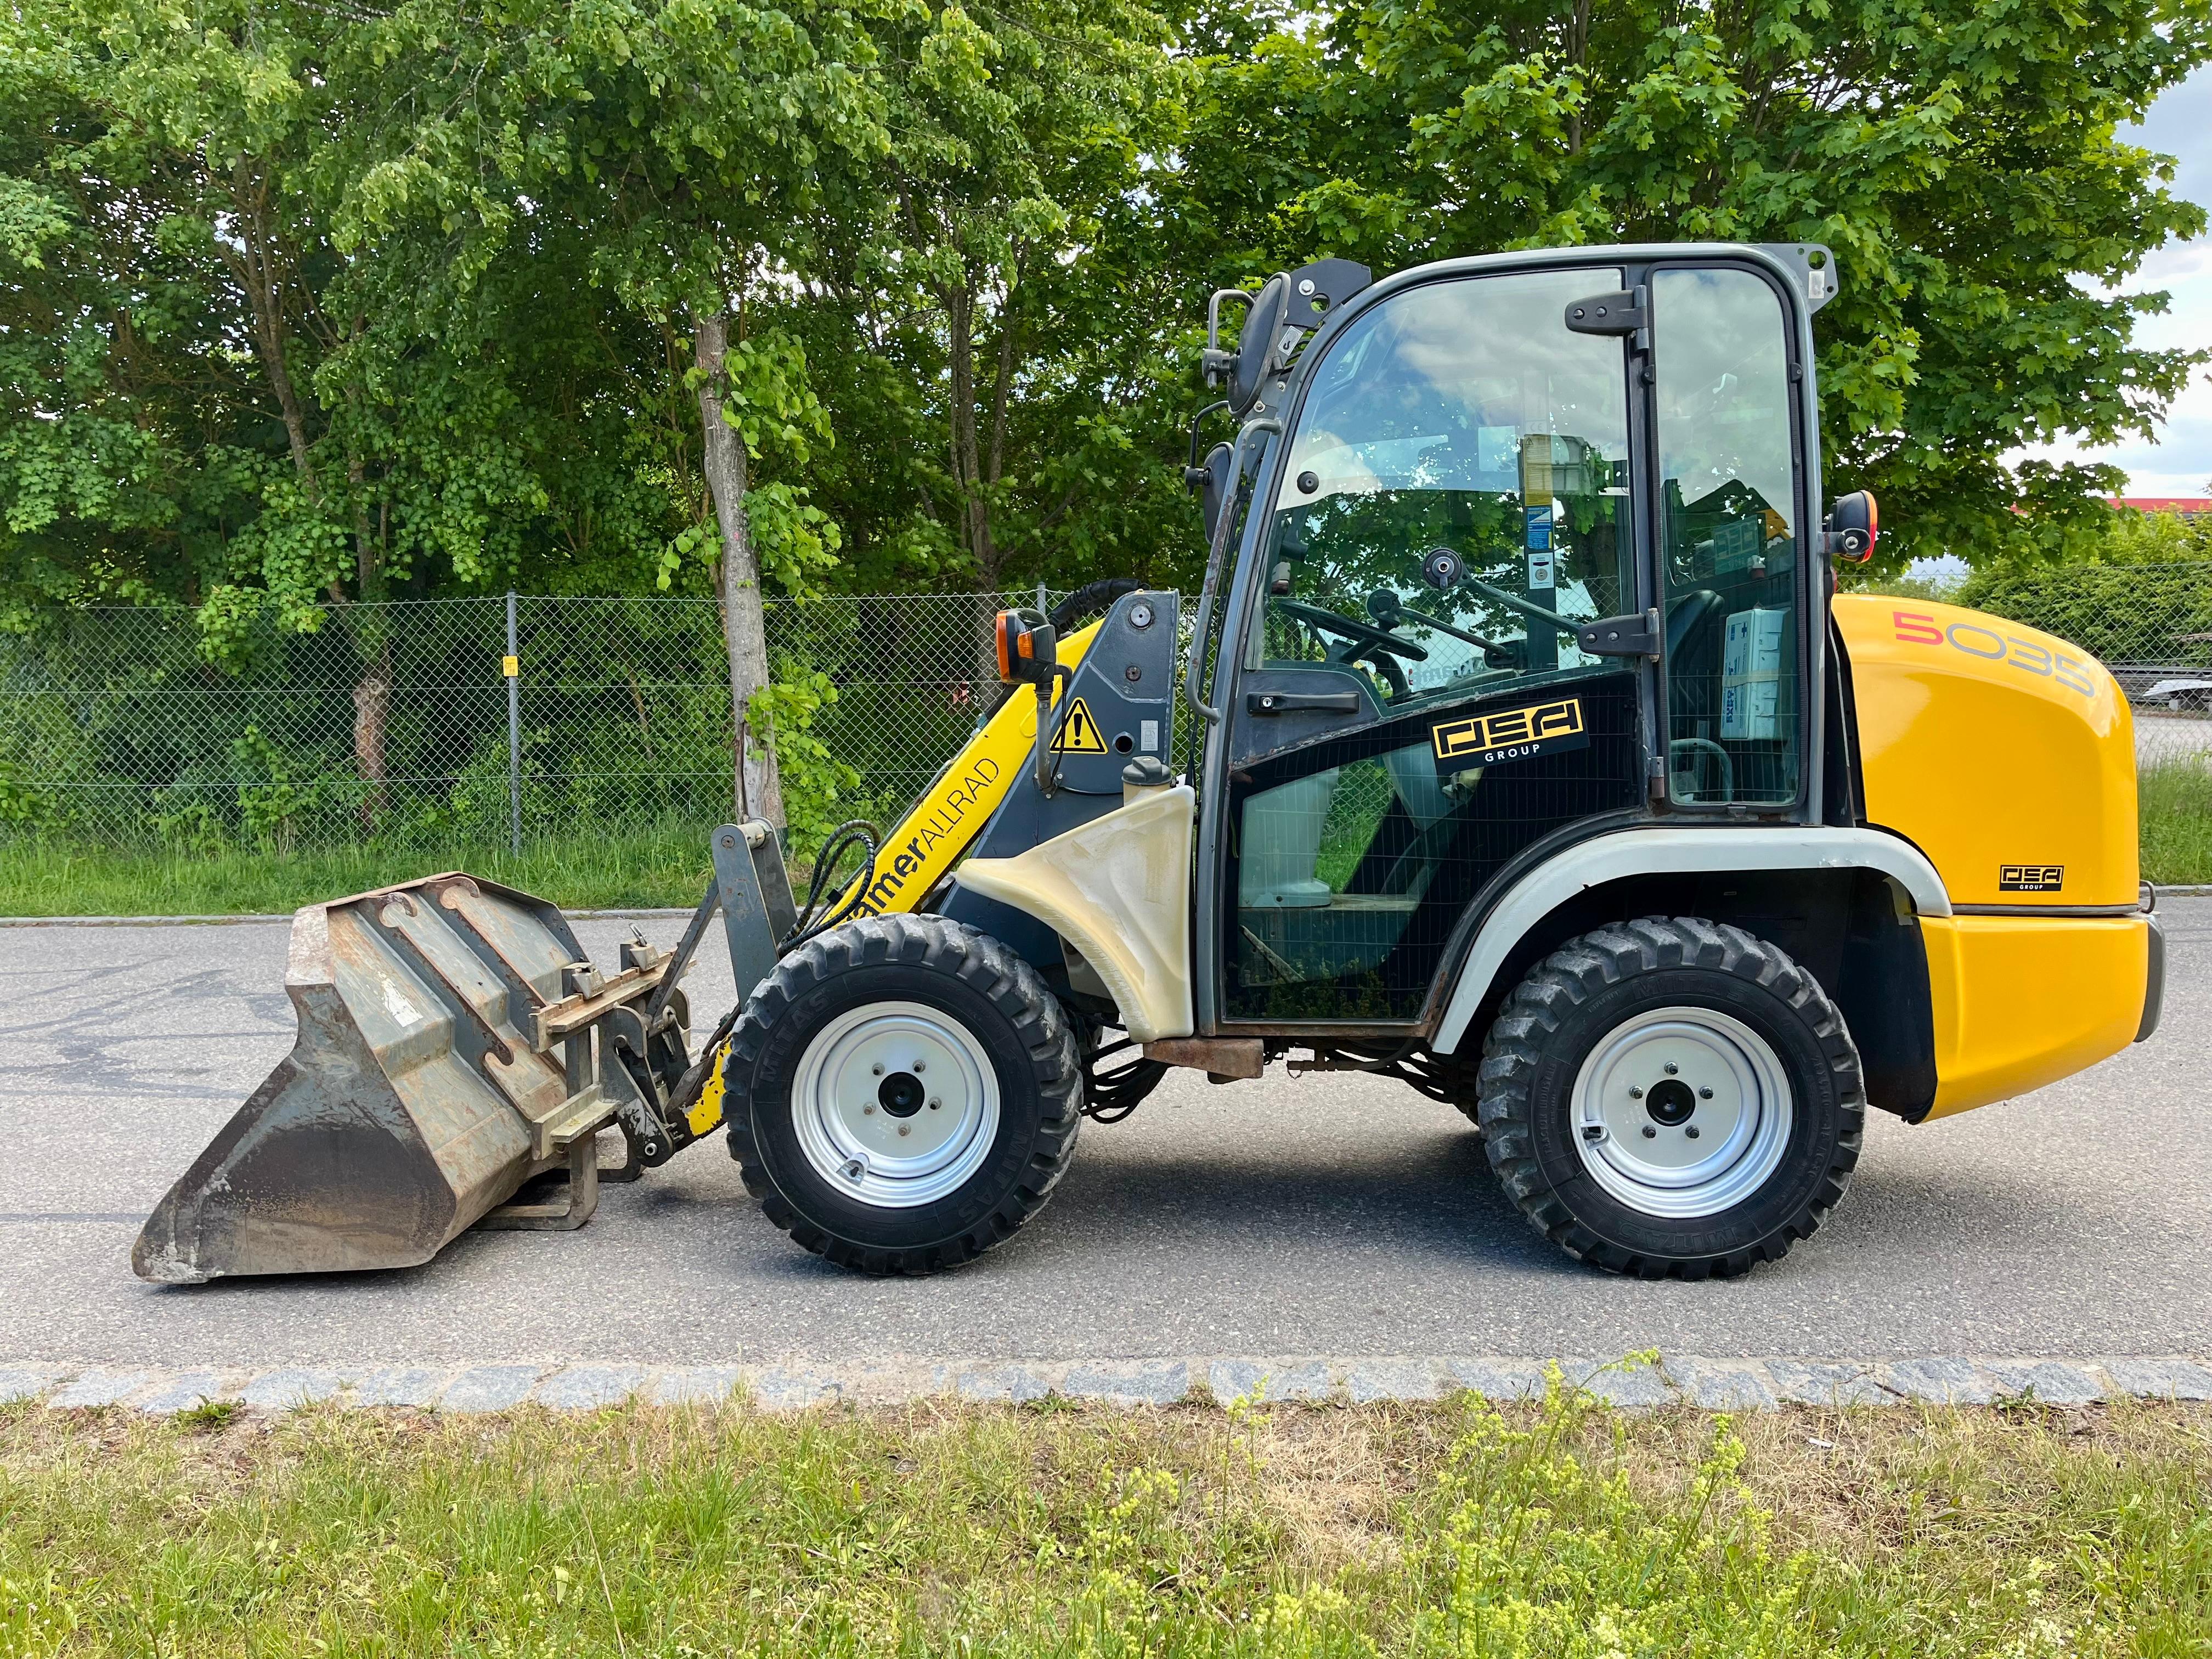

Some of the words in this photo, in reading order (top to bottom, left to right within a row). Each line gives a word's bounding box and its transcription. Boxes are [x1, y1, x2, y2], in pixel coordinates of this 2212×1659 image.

[1893, 611, 2095, 697] 5035
[1485, 744, 1540, 762] GROUP
[1632, 972, 1749, 1003] MITAS
[759, 989, 828, 1082] MITAS
[947, 1127, 1030, 1224] MITAS
[1618, 1222, 1738, 1253] MITAS
